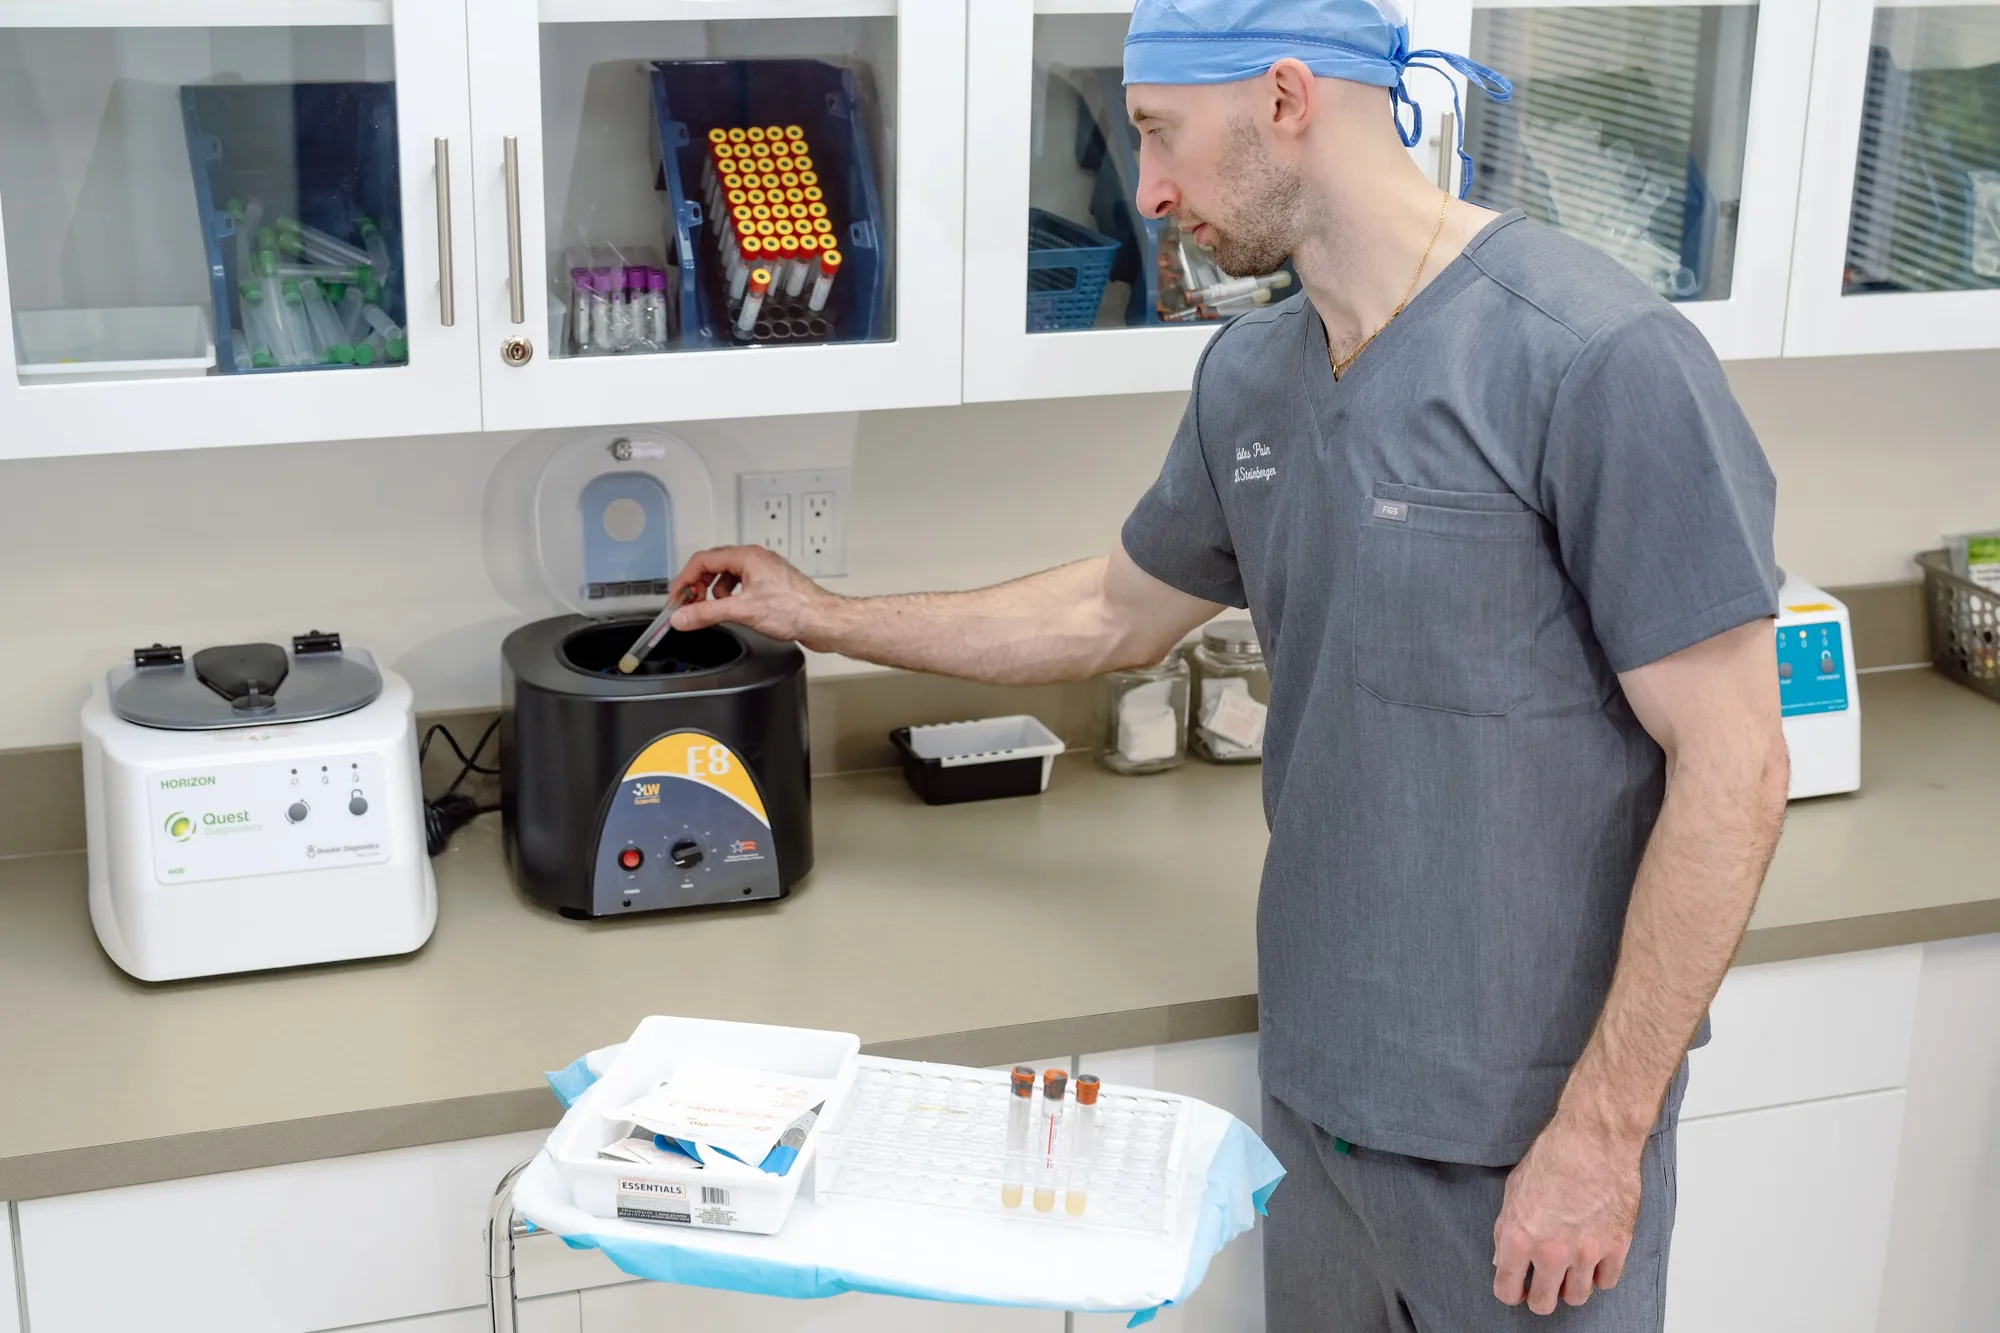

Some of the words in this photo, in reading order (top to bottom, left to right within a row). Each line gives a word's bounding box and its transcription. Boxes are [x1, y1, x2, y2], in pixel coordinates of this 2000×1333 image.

[1252, 442, 1271, 457] Pain
[1382, 505, 1398, 516] FIGS
[687, 744, 730, 778] E8
[160, 776, 216, 790] HORIZON
[643, 783, 661, 797] LW
[202, 810, 250, 826] Quest
[622, 1182, 682, 1194] ESSENTIALS
